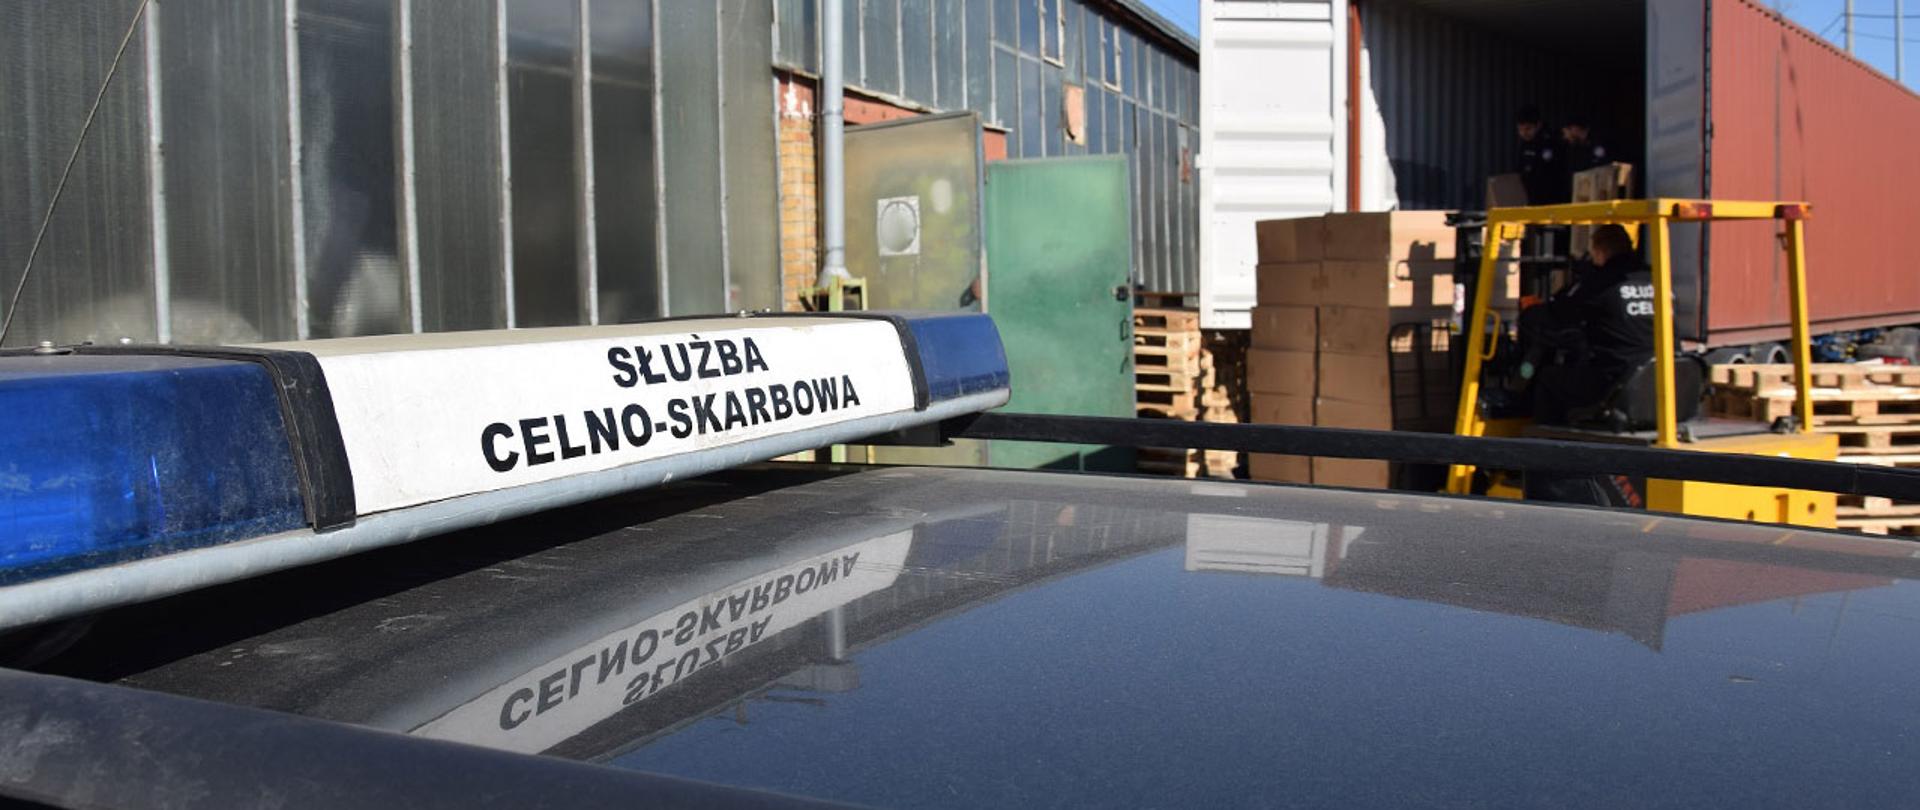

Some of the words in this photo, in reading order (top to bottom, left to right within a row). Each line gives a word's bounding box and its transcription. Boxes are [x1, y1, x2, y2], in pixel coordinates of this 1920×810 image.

[1626, 301, 1655, 315] CEL
[607, 334, 769, 388] SŁUŻBA
[480, 374, 861, 473] CELNO-SKARBOWA
